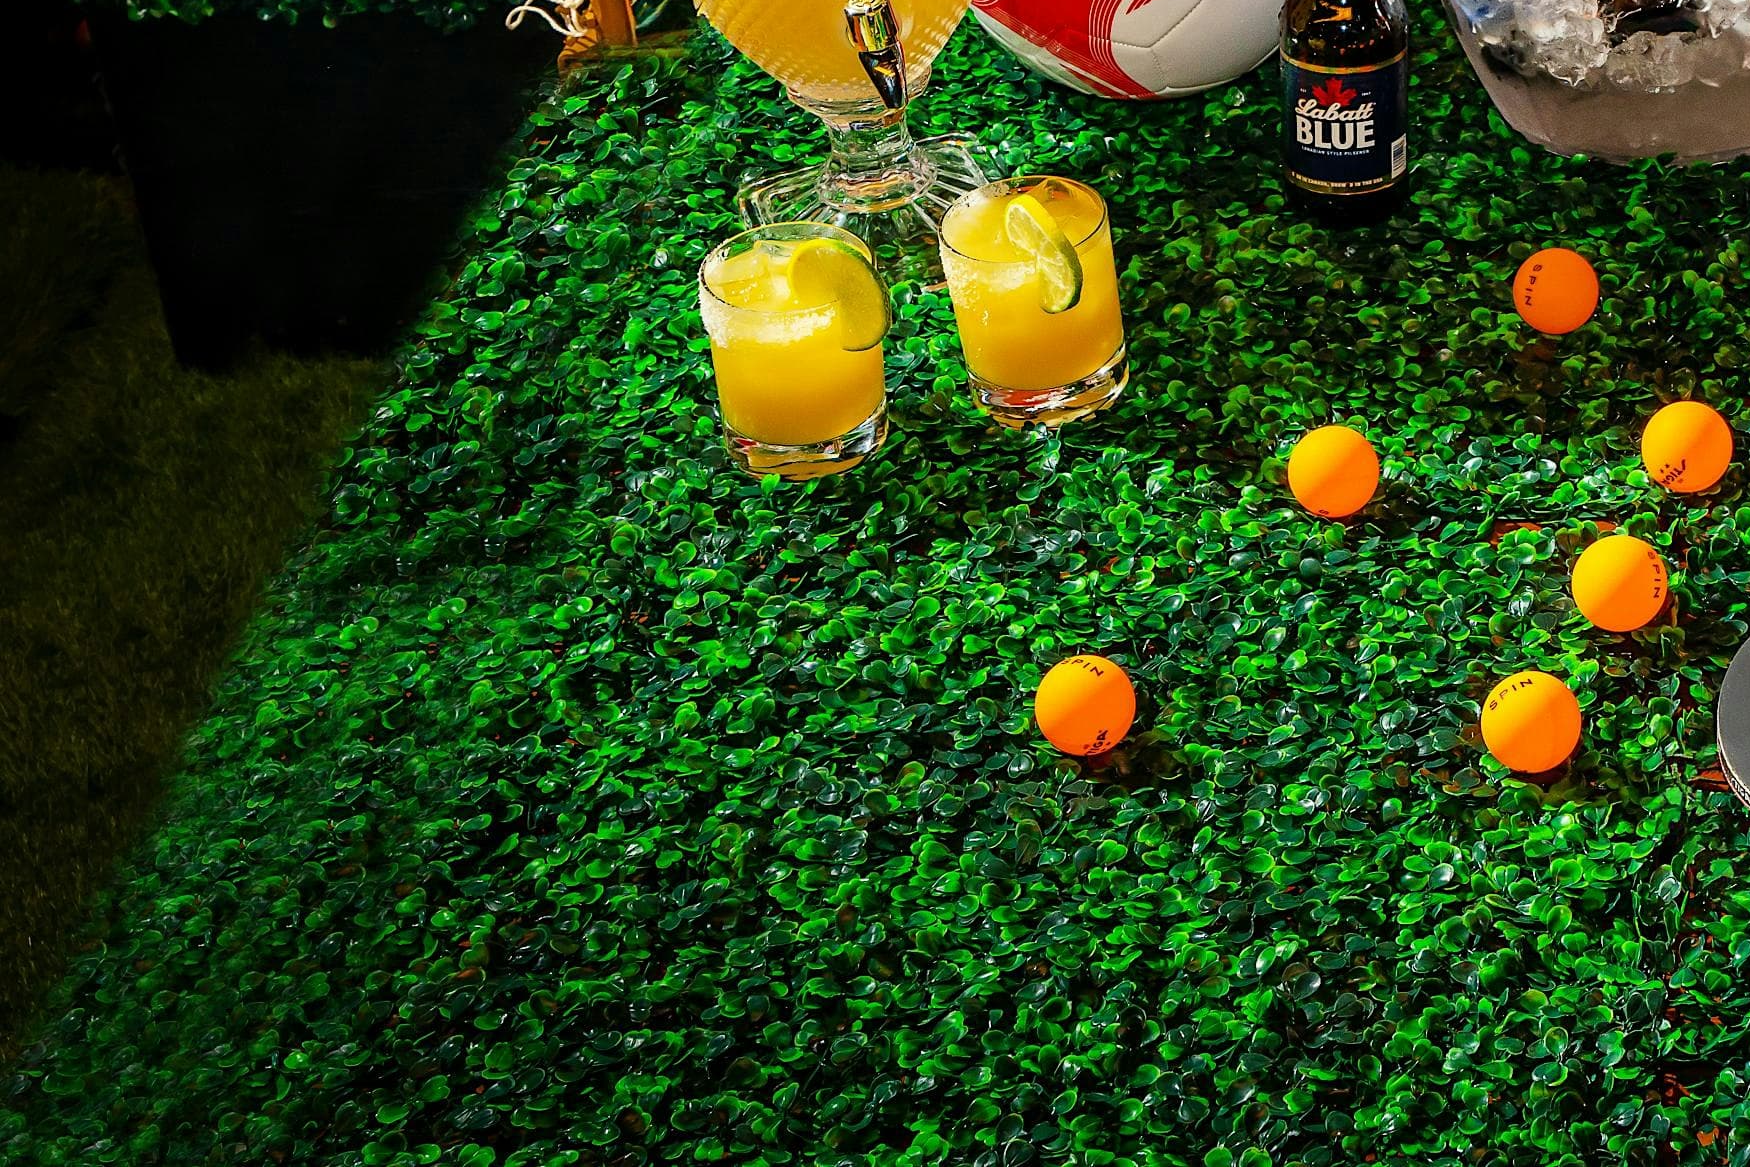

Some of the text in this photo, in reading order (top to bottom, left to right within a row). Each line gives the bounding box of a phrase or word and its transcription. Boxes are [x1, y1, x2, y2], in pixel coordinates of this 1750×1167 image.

[1294, 97, 1375, 122] Labatt
[1295, 114, 1375, 150] BLUE
[1525, 264, 1543, 306] SPIN
[1647, 551, 1662, 599] SPIN
[1060, 658, 1105, 677] SPIN
[1489, 678, 1534, 711] SPIN
